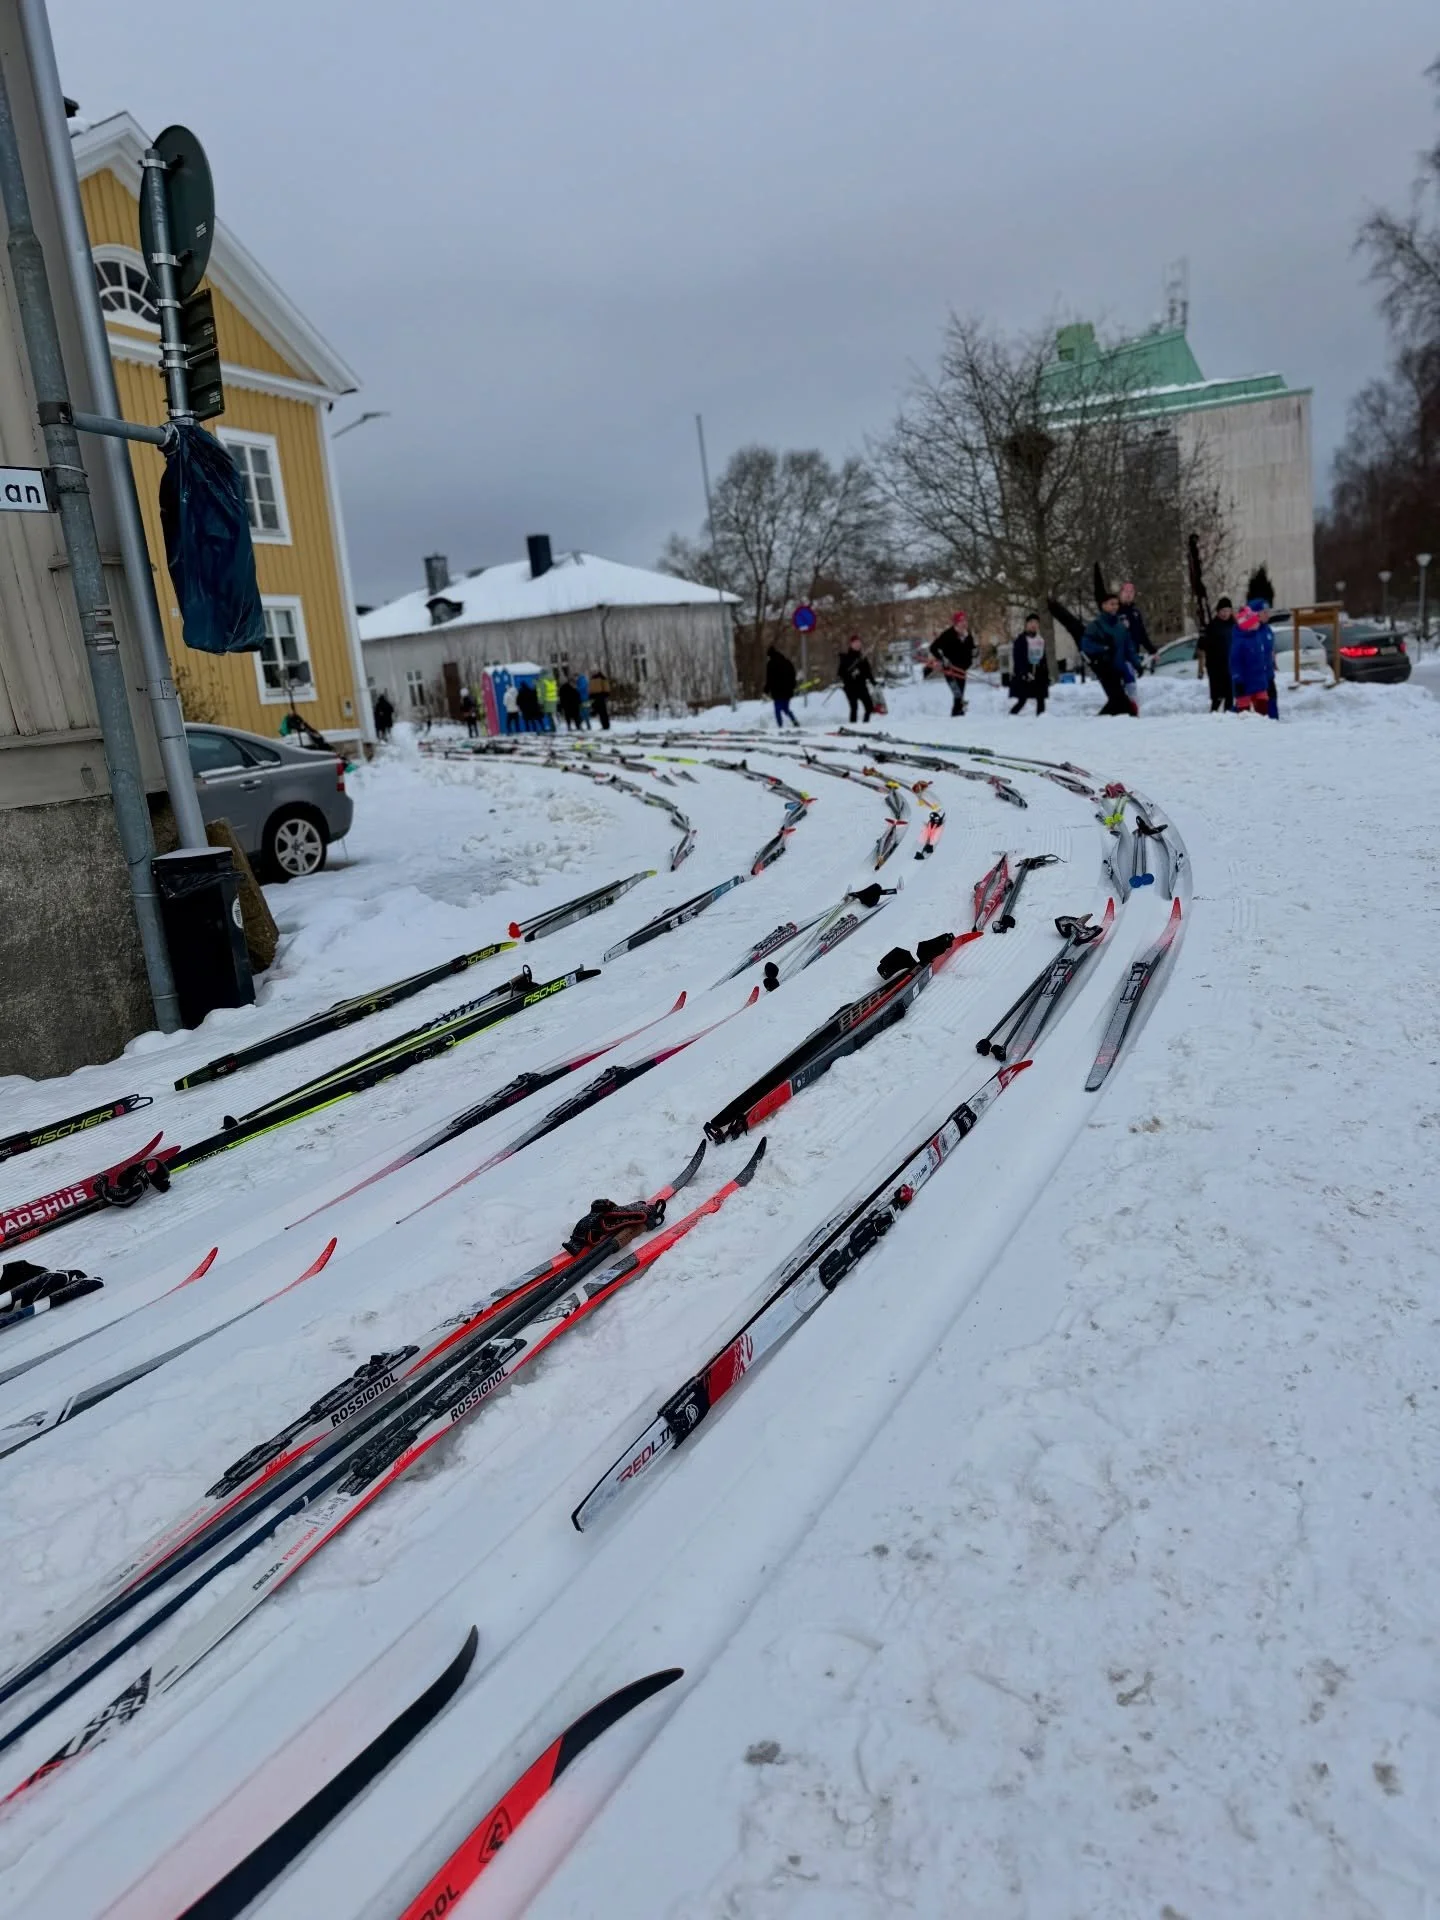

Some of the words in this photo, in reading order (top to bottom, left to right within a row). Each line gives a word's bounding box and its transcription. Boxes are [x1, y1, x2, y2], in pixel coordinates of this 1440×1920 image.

[0, 483, 41, 504] an
[523, 978, 569, 1007] FISCHER
[30, 1109, 114, 1147] FISCHER
[0, 1187, 88, 1236] ADSHUS
[330, 1371, 399, 1428] ROSSIGNOL
[450, 1366, 509, 1423] ROSSIGNOL
[252, 1562, 284, 1591] DELTA
